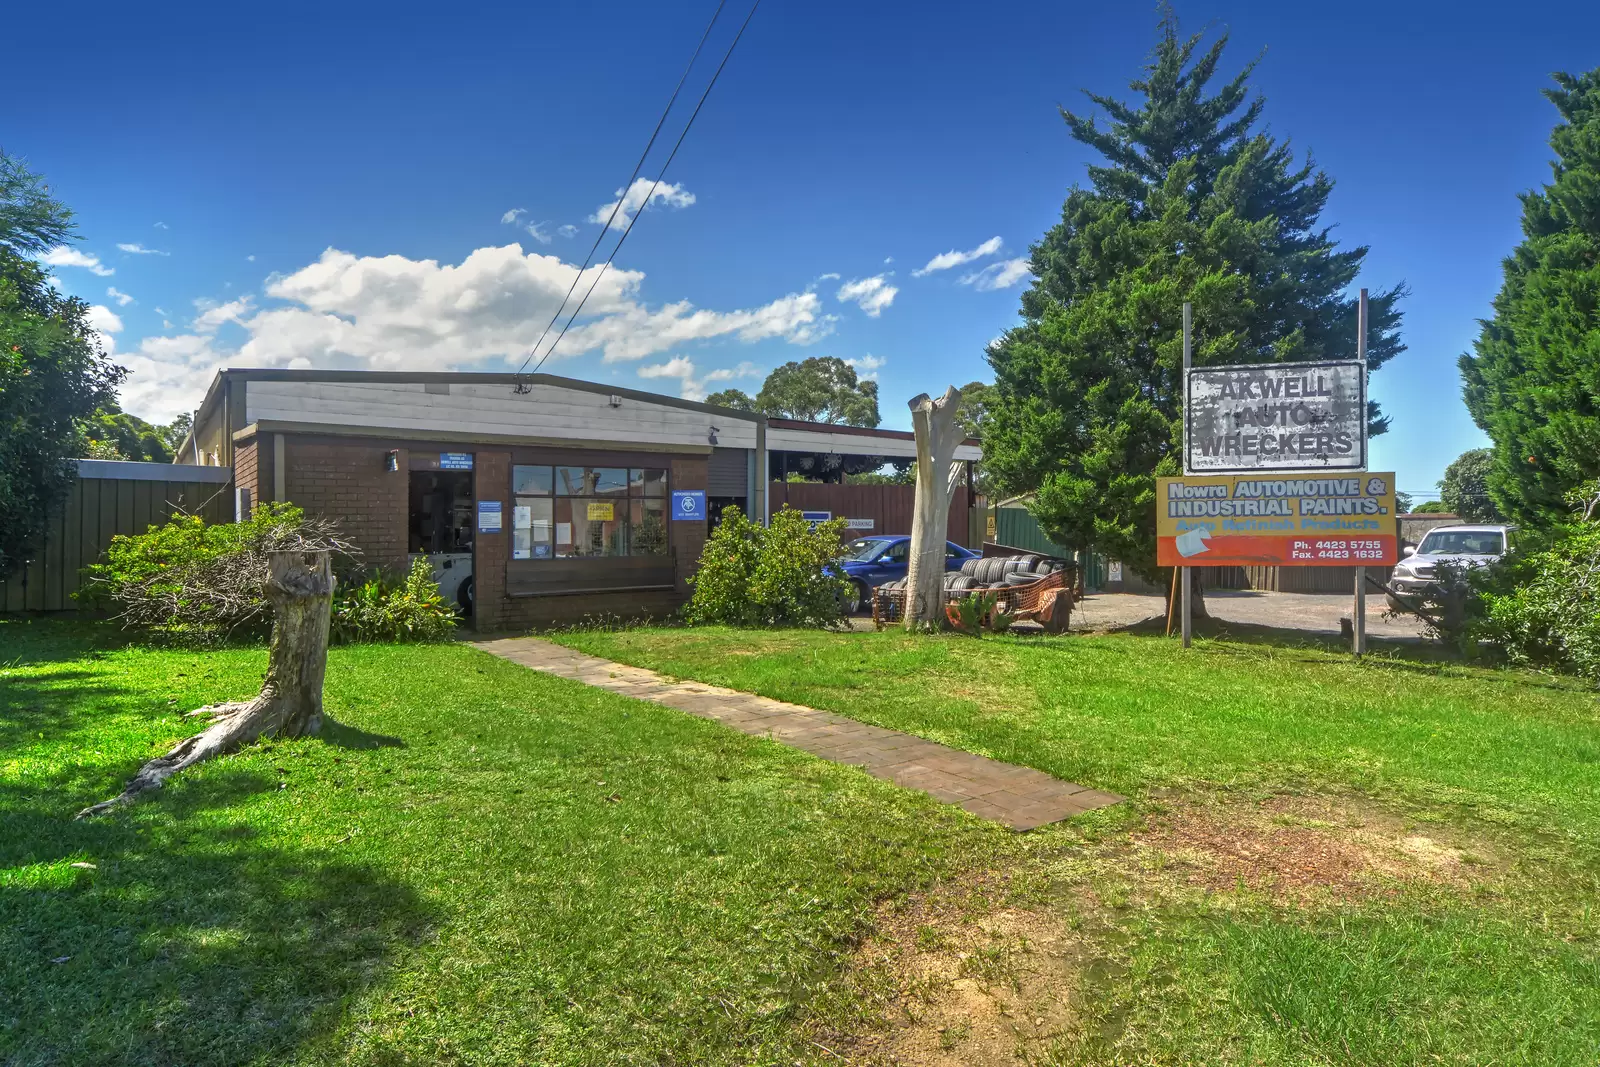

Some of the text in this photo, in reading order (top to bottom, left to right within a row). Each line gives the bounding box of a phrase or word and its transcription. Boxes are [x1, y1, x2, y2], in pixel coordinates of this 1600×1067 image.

[1219, 375, 1331, 400] AKWELL
[1238, 401, 1312, 428] AUTO
[1201, 431, 1353, 457] WRECKERS
[1168, 477, 1387, 500] Nowra AUTOMOTIVE &
[1168, 497, 1388, 518] INDUSTRIAL PAINTS.
[1221, 518, 1295, 531] Refinish
[1301, 518, 1380, 530] Products
[1292, 550, 1383, 559] Fax. 4423 1632
[1294, 541, 1381, 549] Ph. 4423 5755
